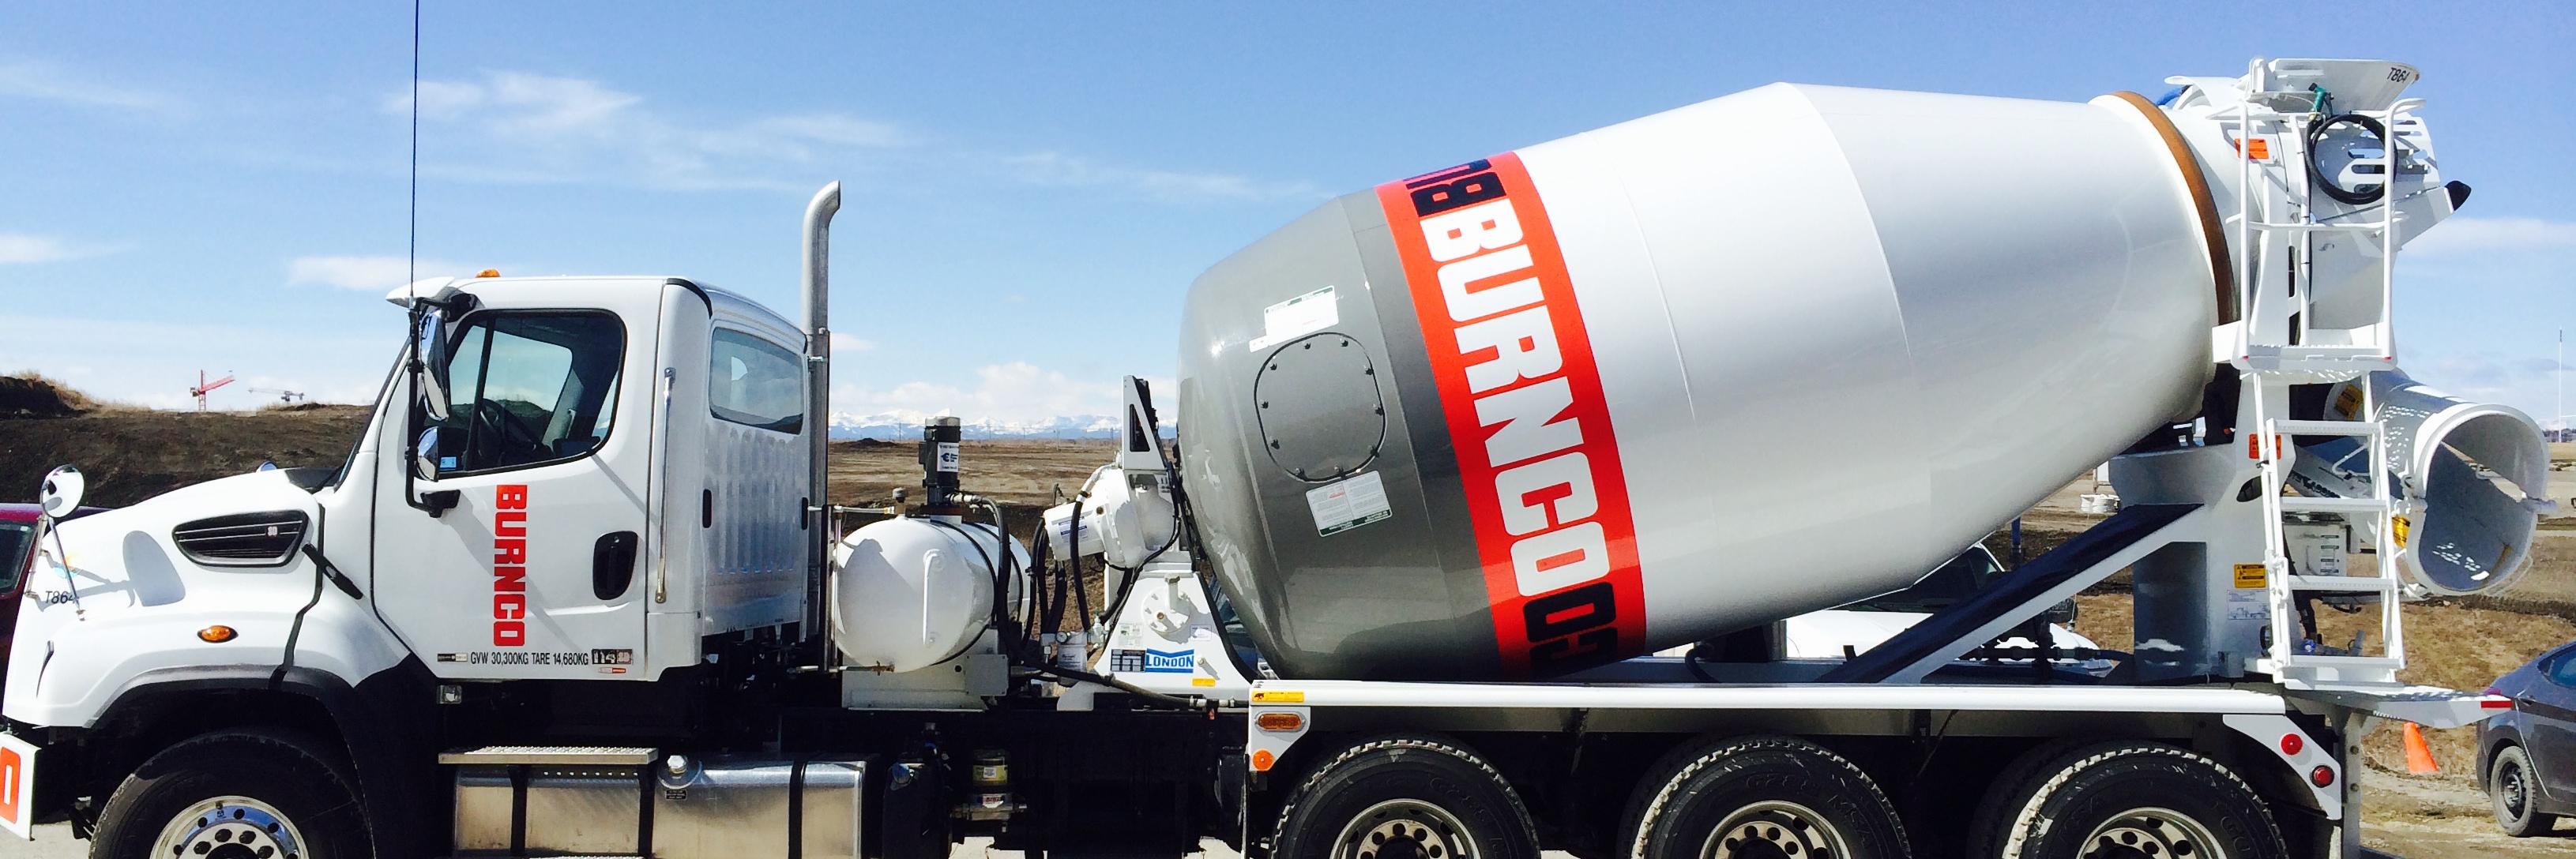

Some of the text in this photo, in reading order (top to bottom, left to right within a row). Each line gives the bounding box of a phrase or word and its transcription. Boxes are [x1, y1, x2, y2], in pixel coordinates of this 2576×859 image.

[1420, 198, 1611, 597] BURNCO
[494, 485, 528, 647] BURNCO
[470, 651, 489, 664] GVW
[491, 651, 528, 666] 30,300KG
[532, 652, 550, 665] TARE
[553, 652, 589, 666] 14,680KG
[1145, 655, 1195, 668] LONDON
